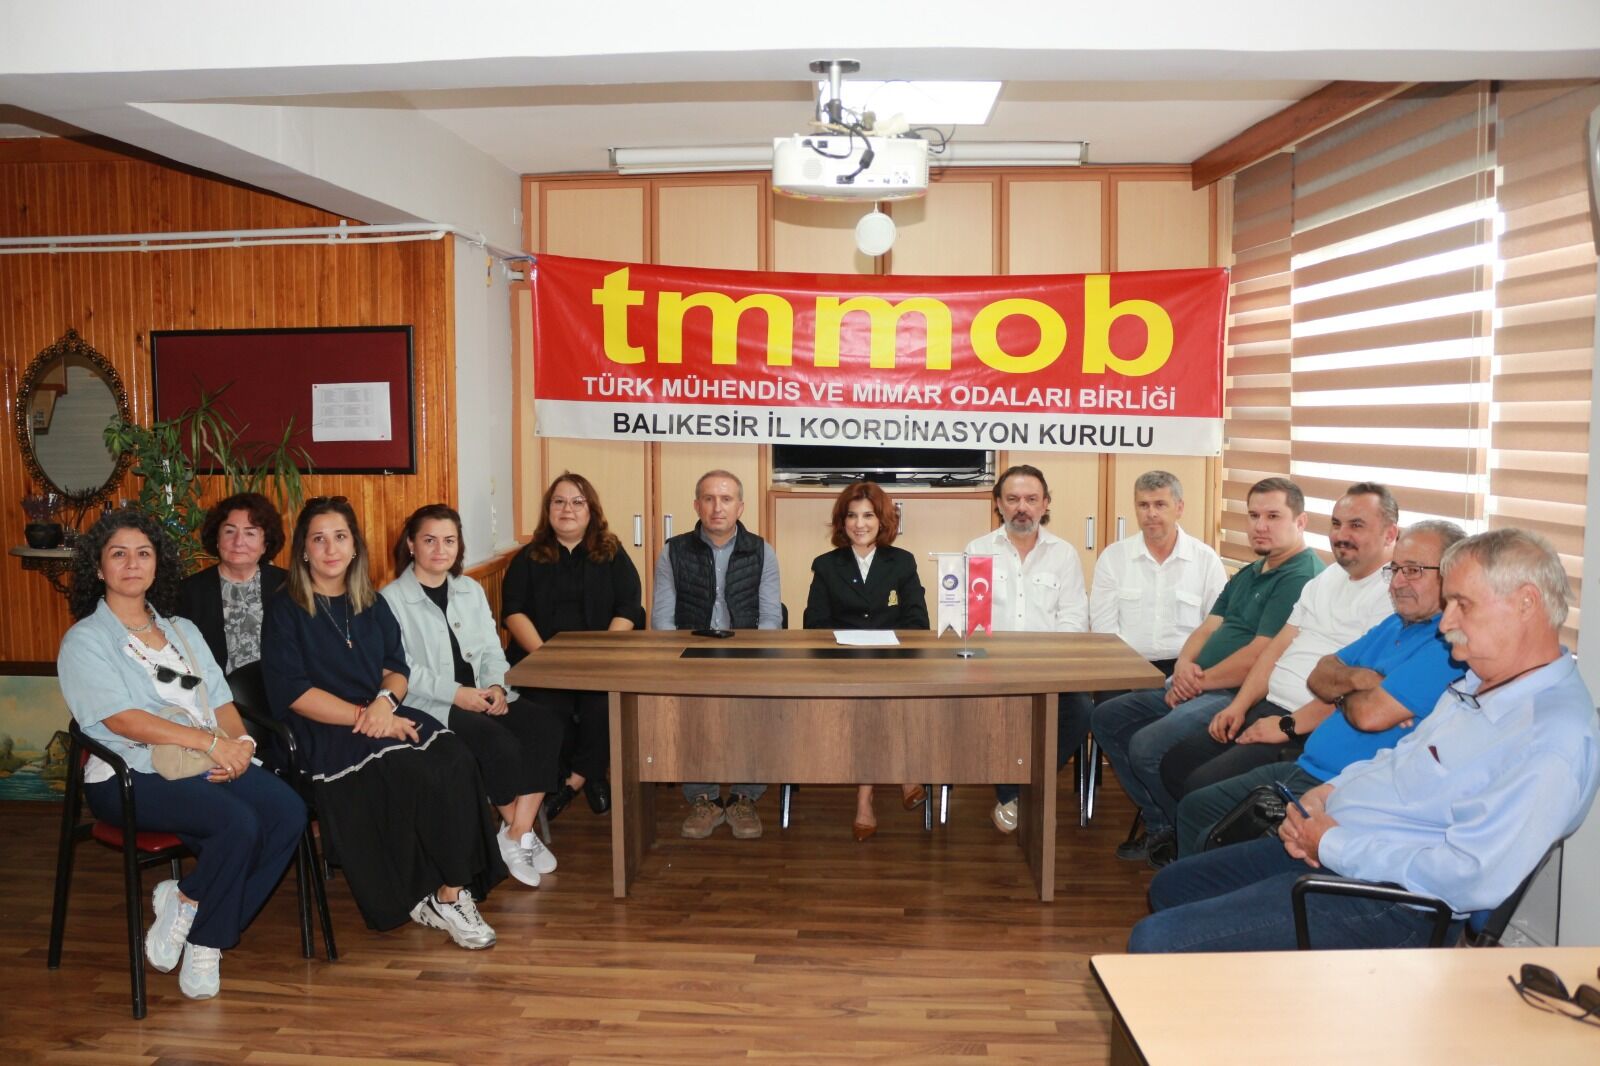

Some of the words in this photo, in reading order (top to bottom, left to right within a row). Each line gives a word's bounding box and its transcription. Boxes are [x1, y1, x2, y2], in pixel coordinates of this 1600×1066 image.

[591, 267, 1174, 377] tmmob
[582, 373, 653, 397] TÜRK
[661, 375, 801, 401] MÜHENDİS
[809, 382, 844, 402] VE
[852, 379, 942, 405] MİMAR
[950, 385, 1071, 408] ODALARI
[1079, 384, 1176, 410] BİRLİĞİ
[613, 410, 758, 437] BALIKESİR
[767, 411, 791, 438] İL
[800, 414, 1029, 445] KOORDİNASYON
[1039, 423, 1154, 447] KURULU
